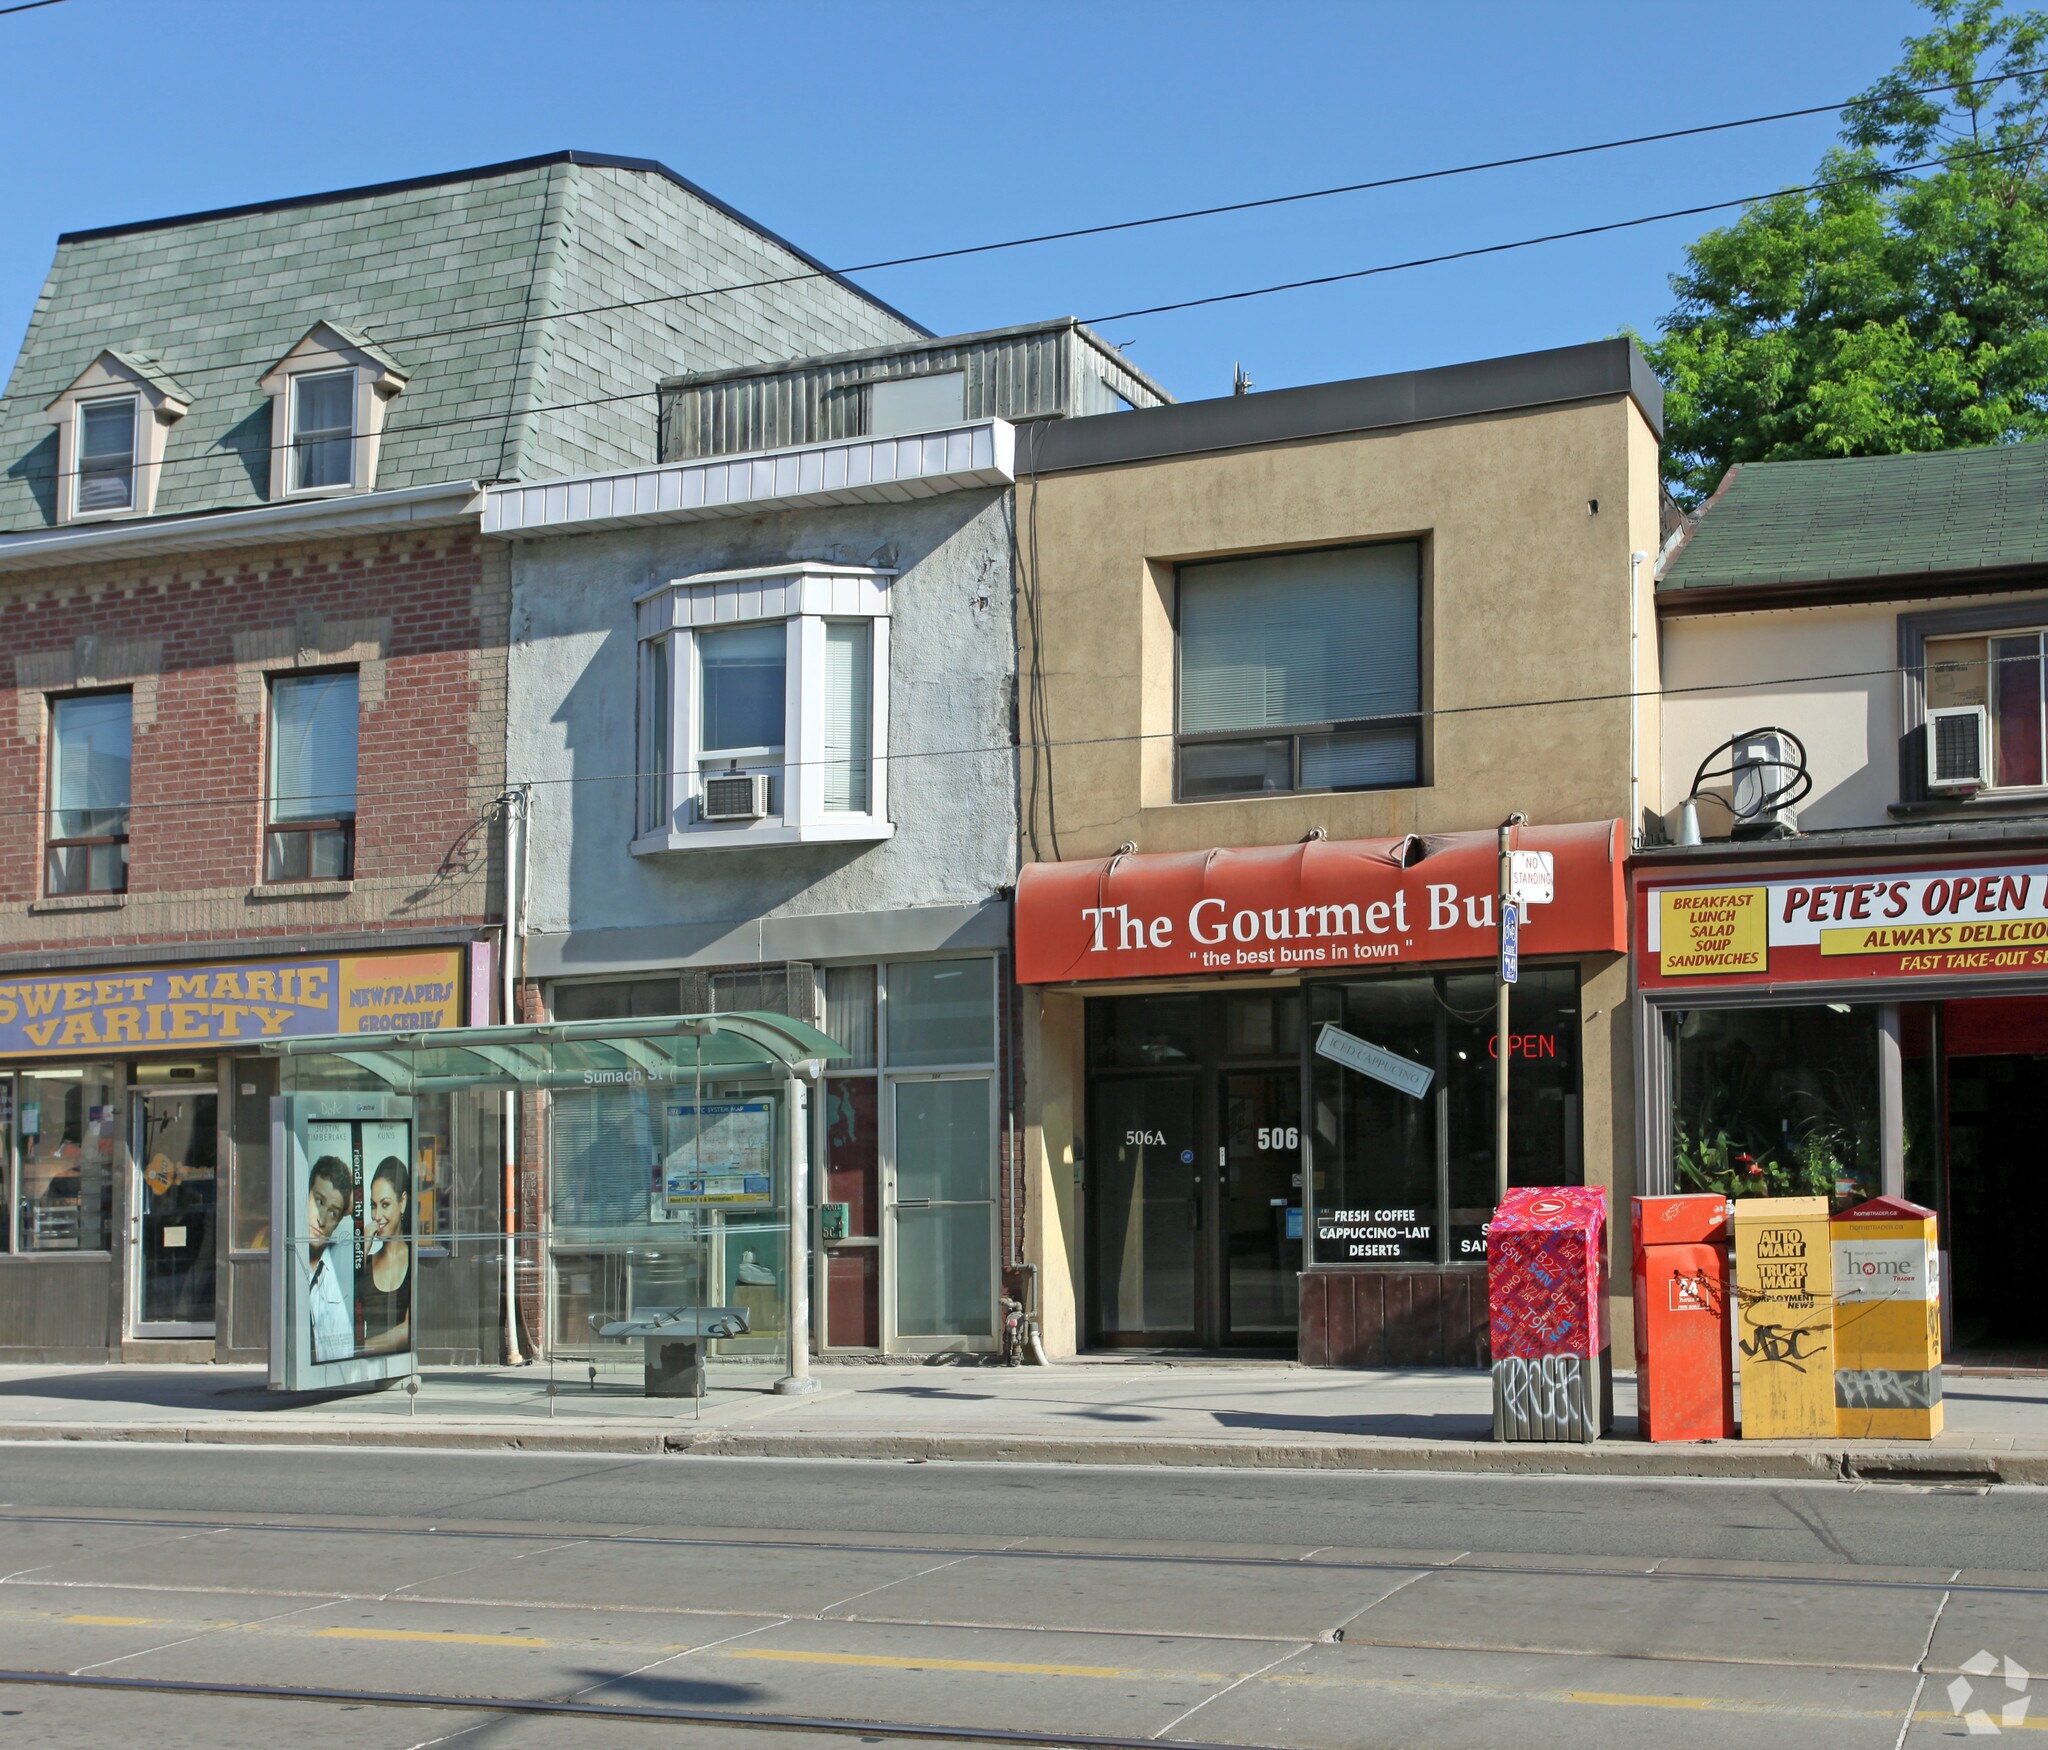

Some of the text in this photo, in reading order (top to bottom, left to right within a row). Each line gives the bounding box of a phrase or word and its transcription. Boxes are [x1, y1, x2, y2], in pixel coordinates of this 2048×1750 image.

[1525, 857, 1538, 868] NO
[1513, 872, 1551, 885] STANDING
[1673, 894, 1753, 910] BREAKFAST
[1783, 880, 1910, 923] PETE'S
[1922, 874, 2030, 916] OPEN
[1082, 903, 1173, 952] The
[1188, 889, 1411, 944] Gourmet
[1689, 910, 1736, 923] LUNCH
[1690, 924, 1735, 937] SALAD
[1863, 922, 2048, 948] ALWAYS DELICIO
[1203, 951, 1231, 966] the
[1236, 948, 1275, 964] best
[1281, 946, 1325, 962] buns
[1332, 943, 1348, 960] in
[1354, 942, 1399, 958] town
[1694, 939, 1731, 952] SOUP
[1667, 952, 1759, 967] SANDWICHES
[1900, 955, 1942, 971] FAST
[1945, 950, 2028, 968] TAKE-OUT
[0, 967, 328, 1024] SWEET MARIE
[349, 981, 453, 1008] NEWSPAPERS
[22, 1003, 295, 1046] VARIETY
[358, 1009, 443, 1032] GROCERIES
[1329, 1037, 1420, 1083] ICED CAPPUCINO
[583, 1068, 663, 1084] Sumach St
[315, 1124, 340, 1132] JUSTIN
[1126, 1130, 1166, 1145] 506A
[1257, 1127, 1299, 1150] 506
[1334, 1210, 1369, 1222] FRESH
[1375, 1209, 1416, 1222] COFFEE
[1760, 1229, 1802, 1244] AUTO
[1349, 1244, 1400, 1256] DESERTS
[1500, 1241, 1522, 1263] G5N
[1758, 1243, 1805, 1258] MART
[1535, 1250, 1563, 1277] B2Z
[1757, 1263, 1807, 1277] TRUCK
[1844, 1250, 1911, 1276] home
[1528, 1262, 1553, 1287] S4N
[1761, 1276, 1805, 1290] MART
[1679, 1280, 1699, 1297] 24
[1523, 1306, 1552, 1339] T9K
[1549, 1320, 1573, 1342] K4A
